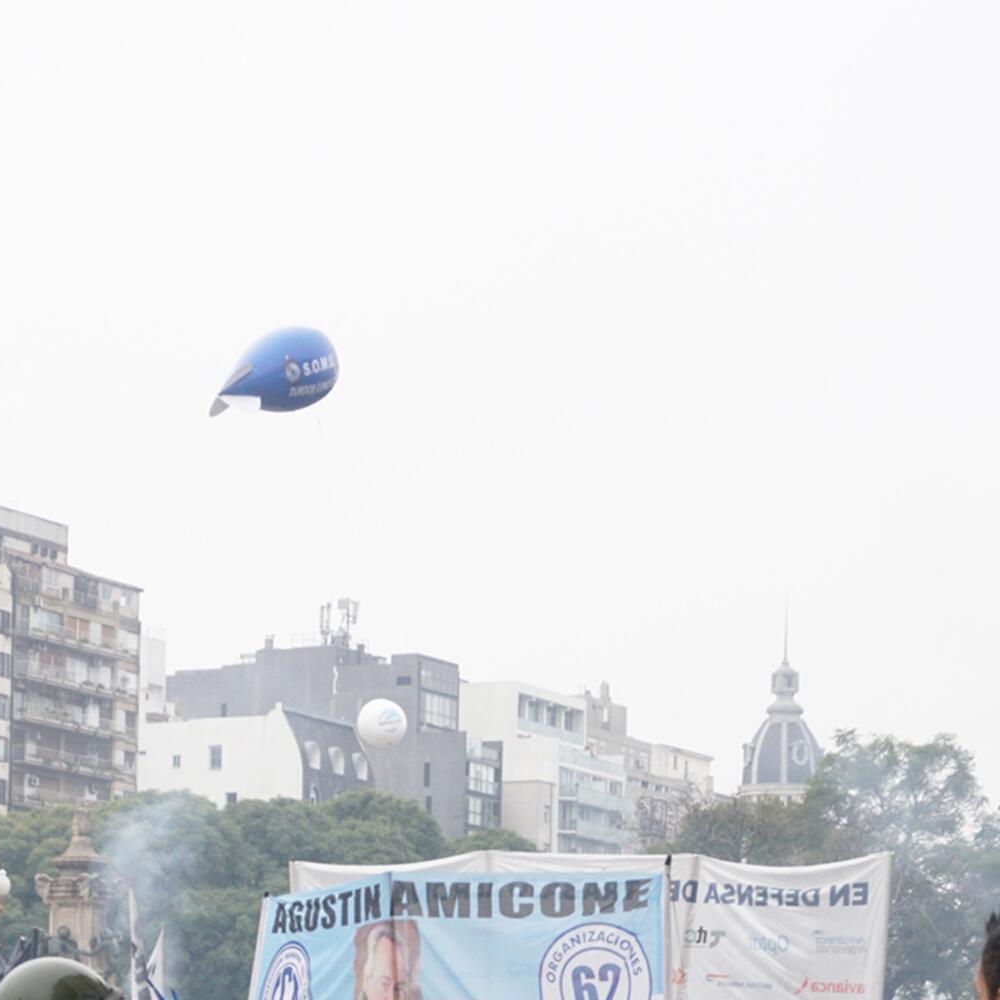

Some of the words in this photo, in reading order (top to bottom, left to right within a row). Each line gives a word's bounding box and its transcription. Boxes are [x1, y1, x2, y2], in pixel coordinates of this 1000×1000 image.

[272, 884, 381, 934] AGUSTIN
[390, 878, 653, 918] AMICONE
[546, 931, 642, 983] ORGANIZACIONES
